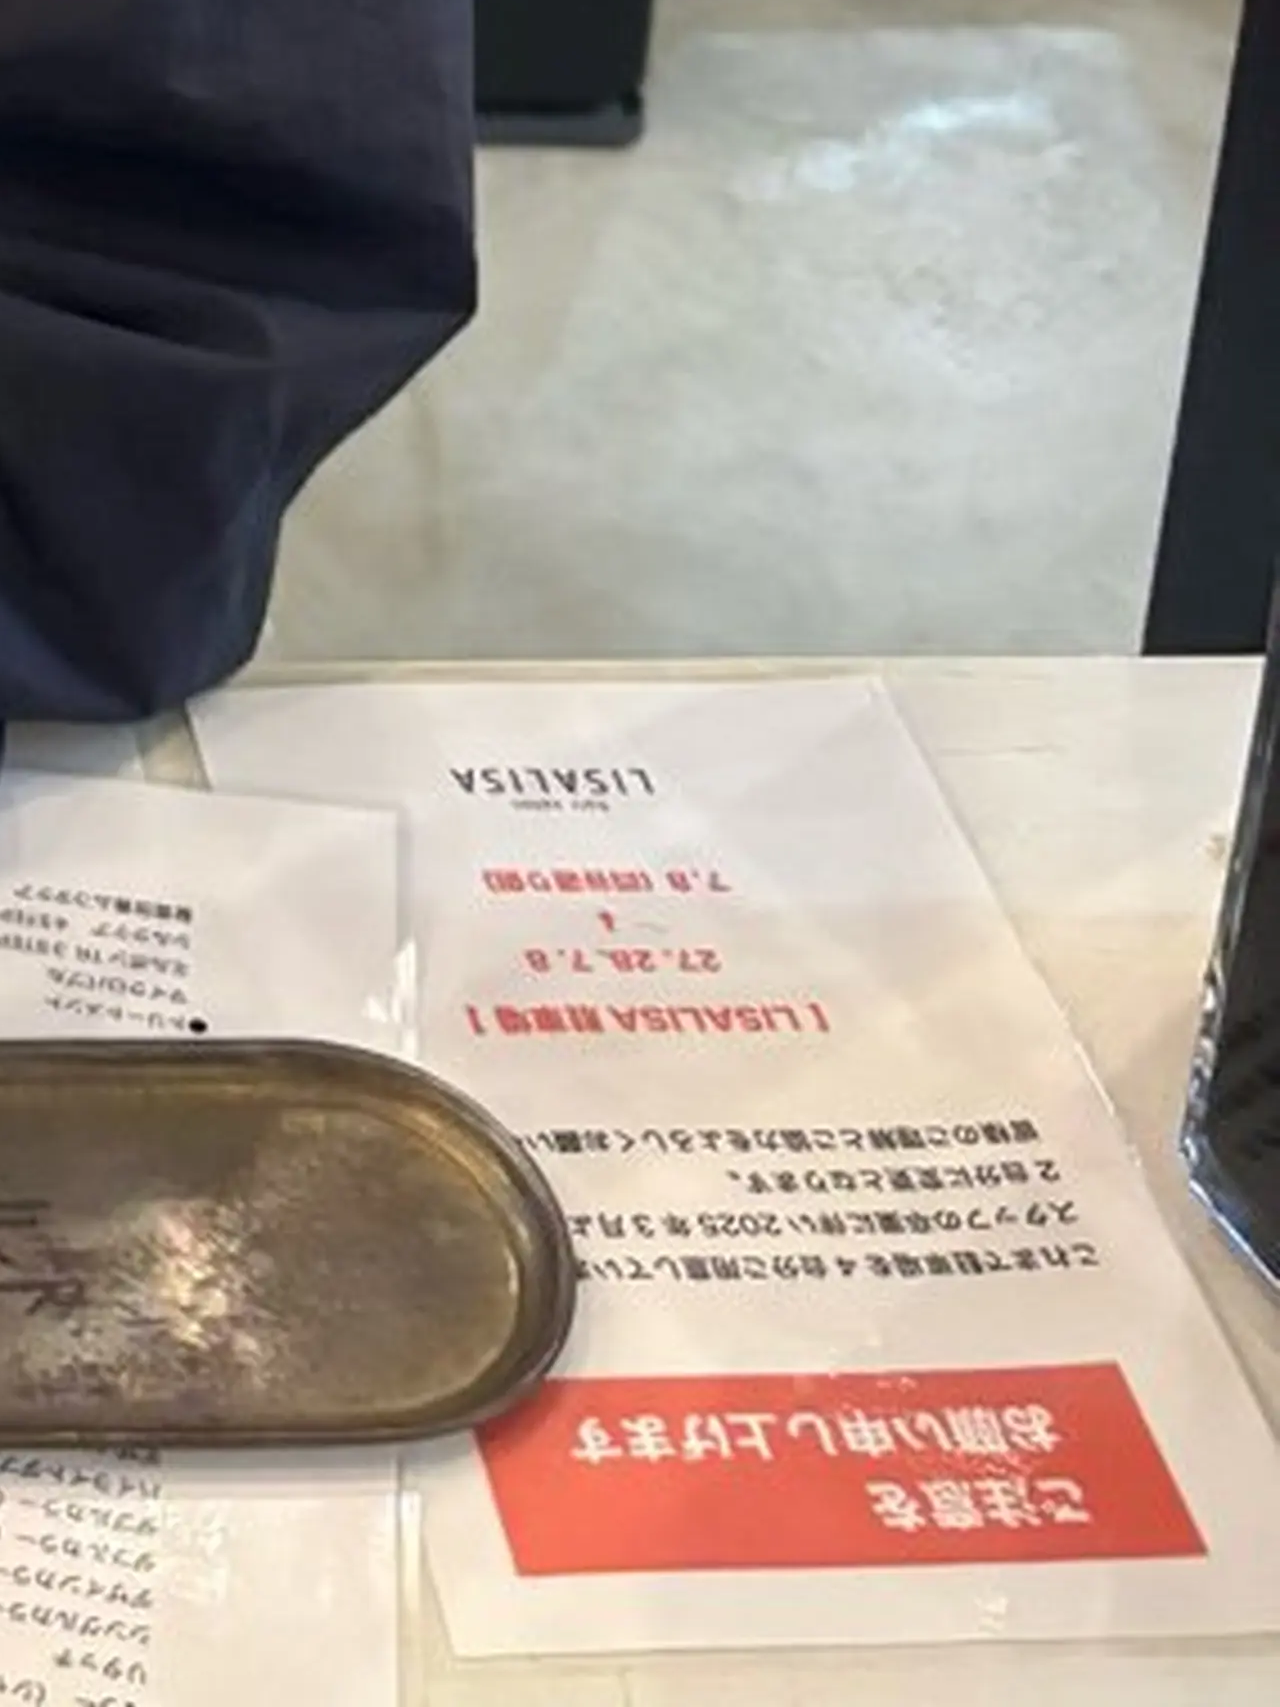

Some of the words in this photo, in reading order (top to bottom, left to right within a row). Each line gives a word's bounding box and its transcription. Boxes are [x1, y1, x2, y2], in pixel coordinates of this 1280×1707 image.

[449, 767, 657, 796] LISALISA
[606, 1004, 802, 1033] LISALISA
[569, 1402, 1062, 1465] お願い申し上げます
[866, 1478, 1094, 1531] ご注意を
